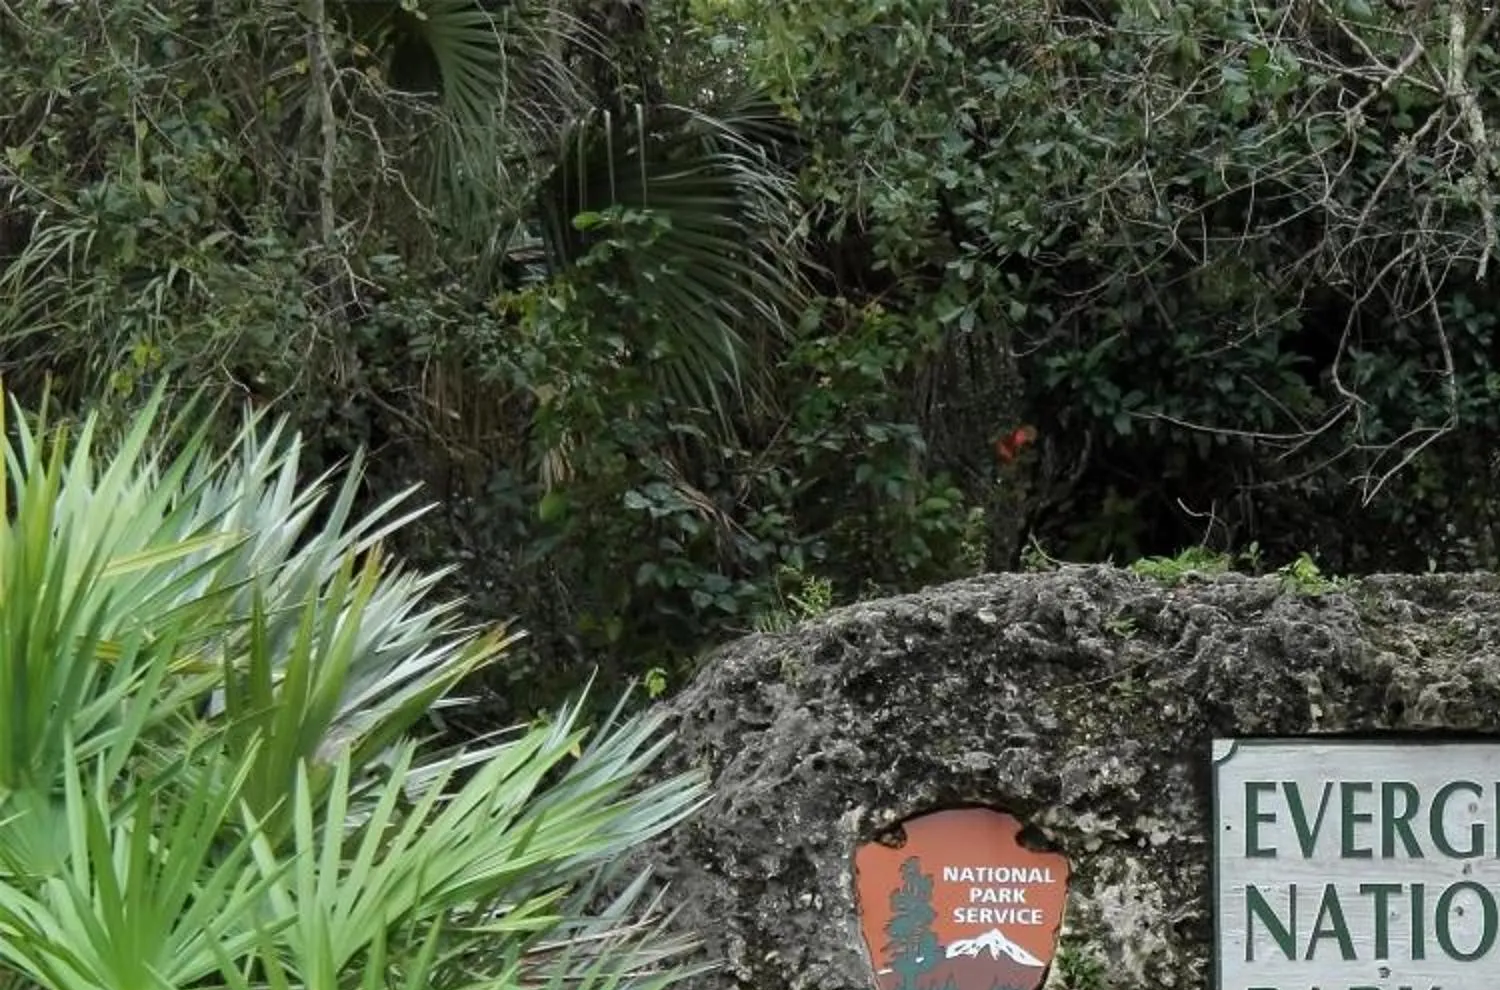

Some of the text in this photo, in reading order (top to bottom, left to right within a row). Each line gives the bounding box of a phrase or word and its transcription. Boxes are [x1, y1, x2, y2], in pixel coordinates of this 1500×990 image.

[943, 866, 1056, 884] NATIONAL
[969, 887, 1026, 904] PARK
[952, 908, 1044, 926] SERVICE
